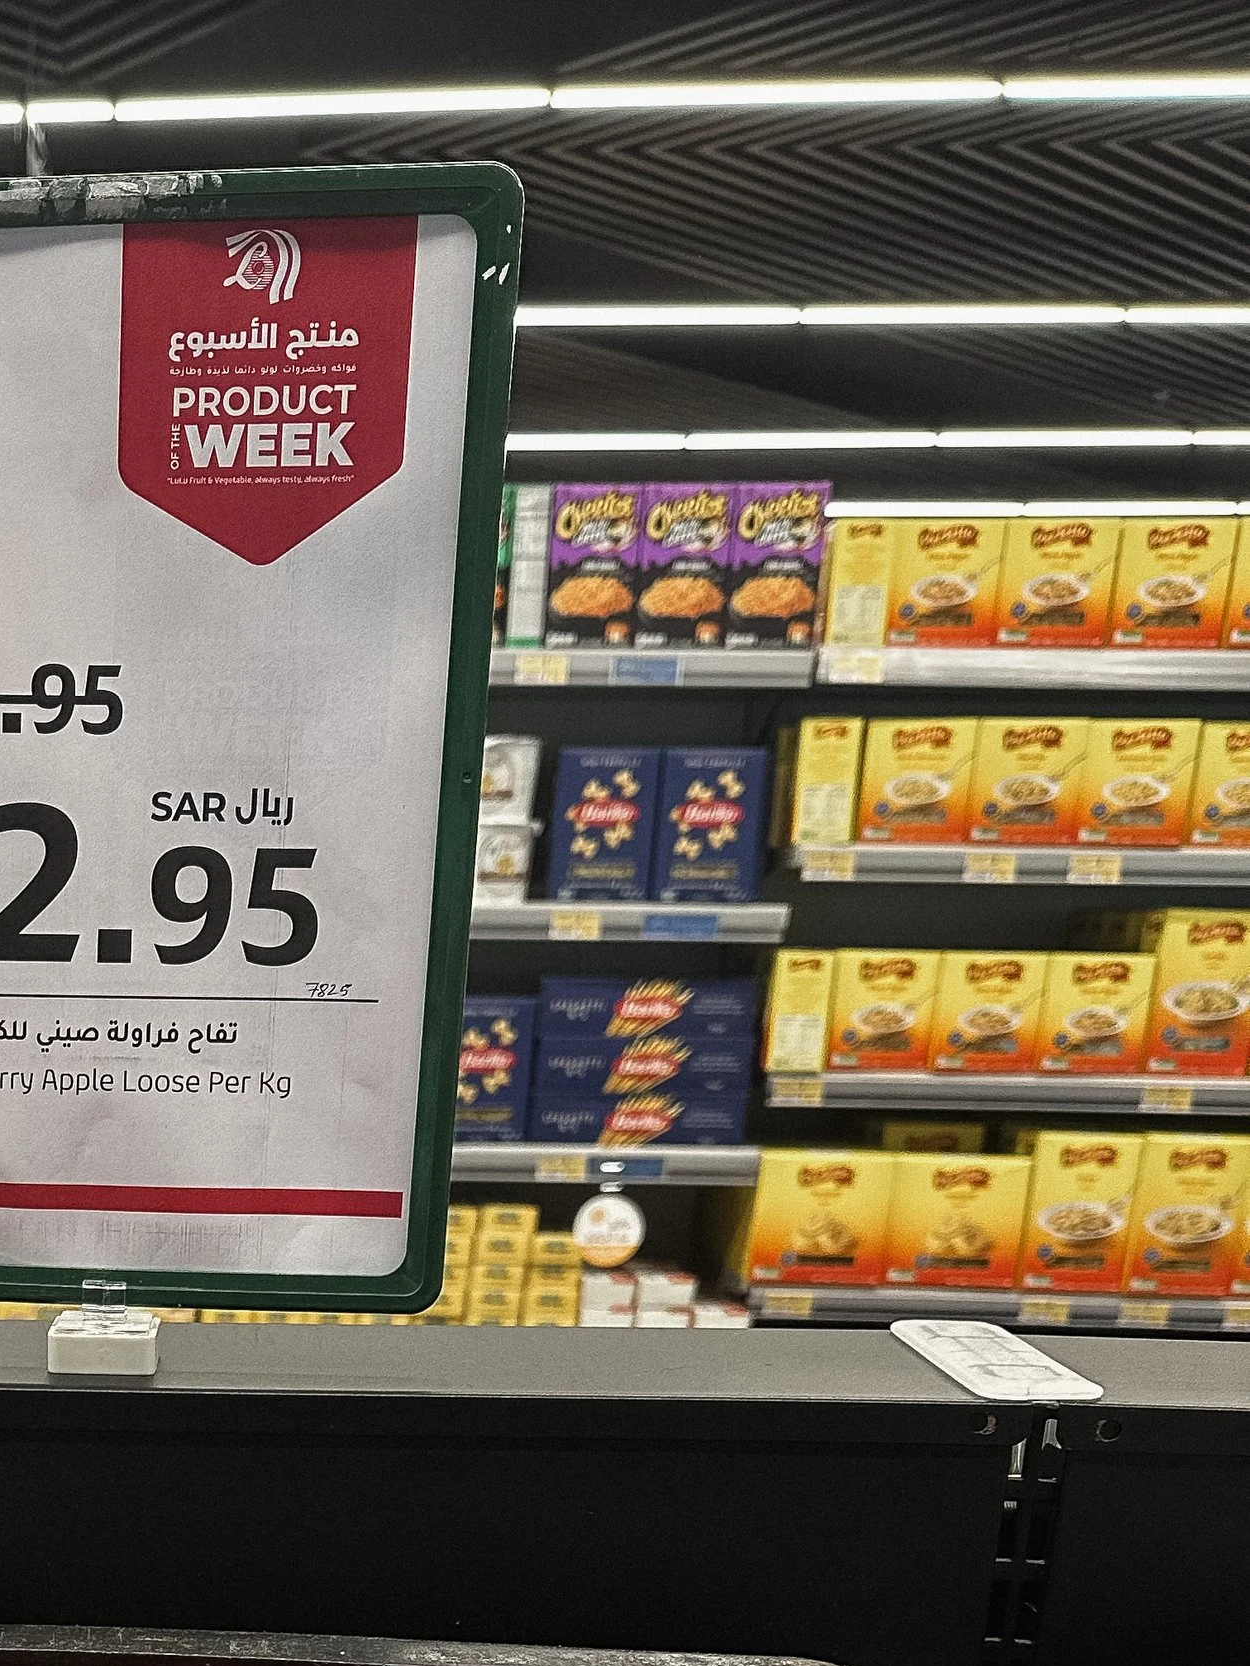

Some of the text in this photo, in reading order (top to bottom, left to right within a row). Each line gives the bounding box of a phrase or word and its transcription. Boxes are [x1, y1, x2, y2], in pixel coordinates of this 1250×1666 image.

[169, 317, 359, 362] منتج الأسبوع
[172, 384, 357, 417] PRODUCT
[170, 423, 181, 470] OF THE
[184, 421, 356, 468] WEEK
[151, 788, 293, 826] SAR ريال
[305, 982, 352, 998] 7825
[37, 1020, 99, 1052] صيني
[108, 1020, 178, 1048] فراولة
[188, 1023, 237, 1054] تفاح
[42, 1068, 113, 1095] Apple
[124, 1071, 199, 1092] Loose
[210, 1072, 251, 1093] Per
[260, 1072, 290, 1098] Kg
